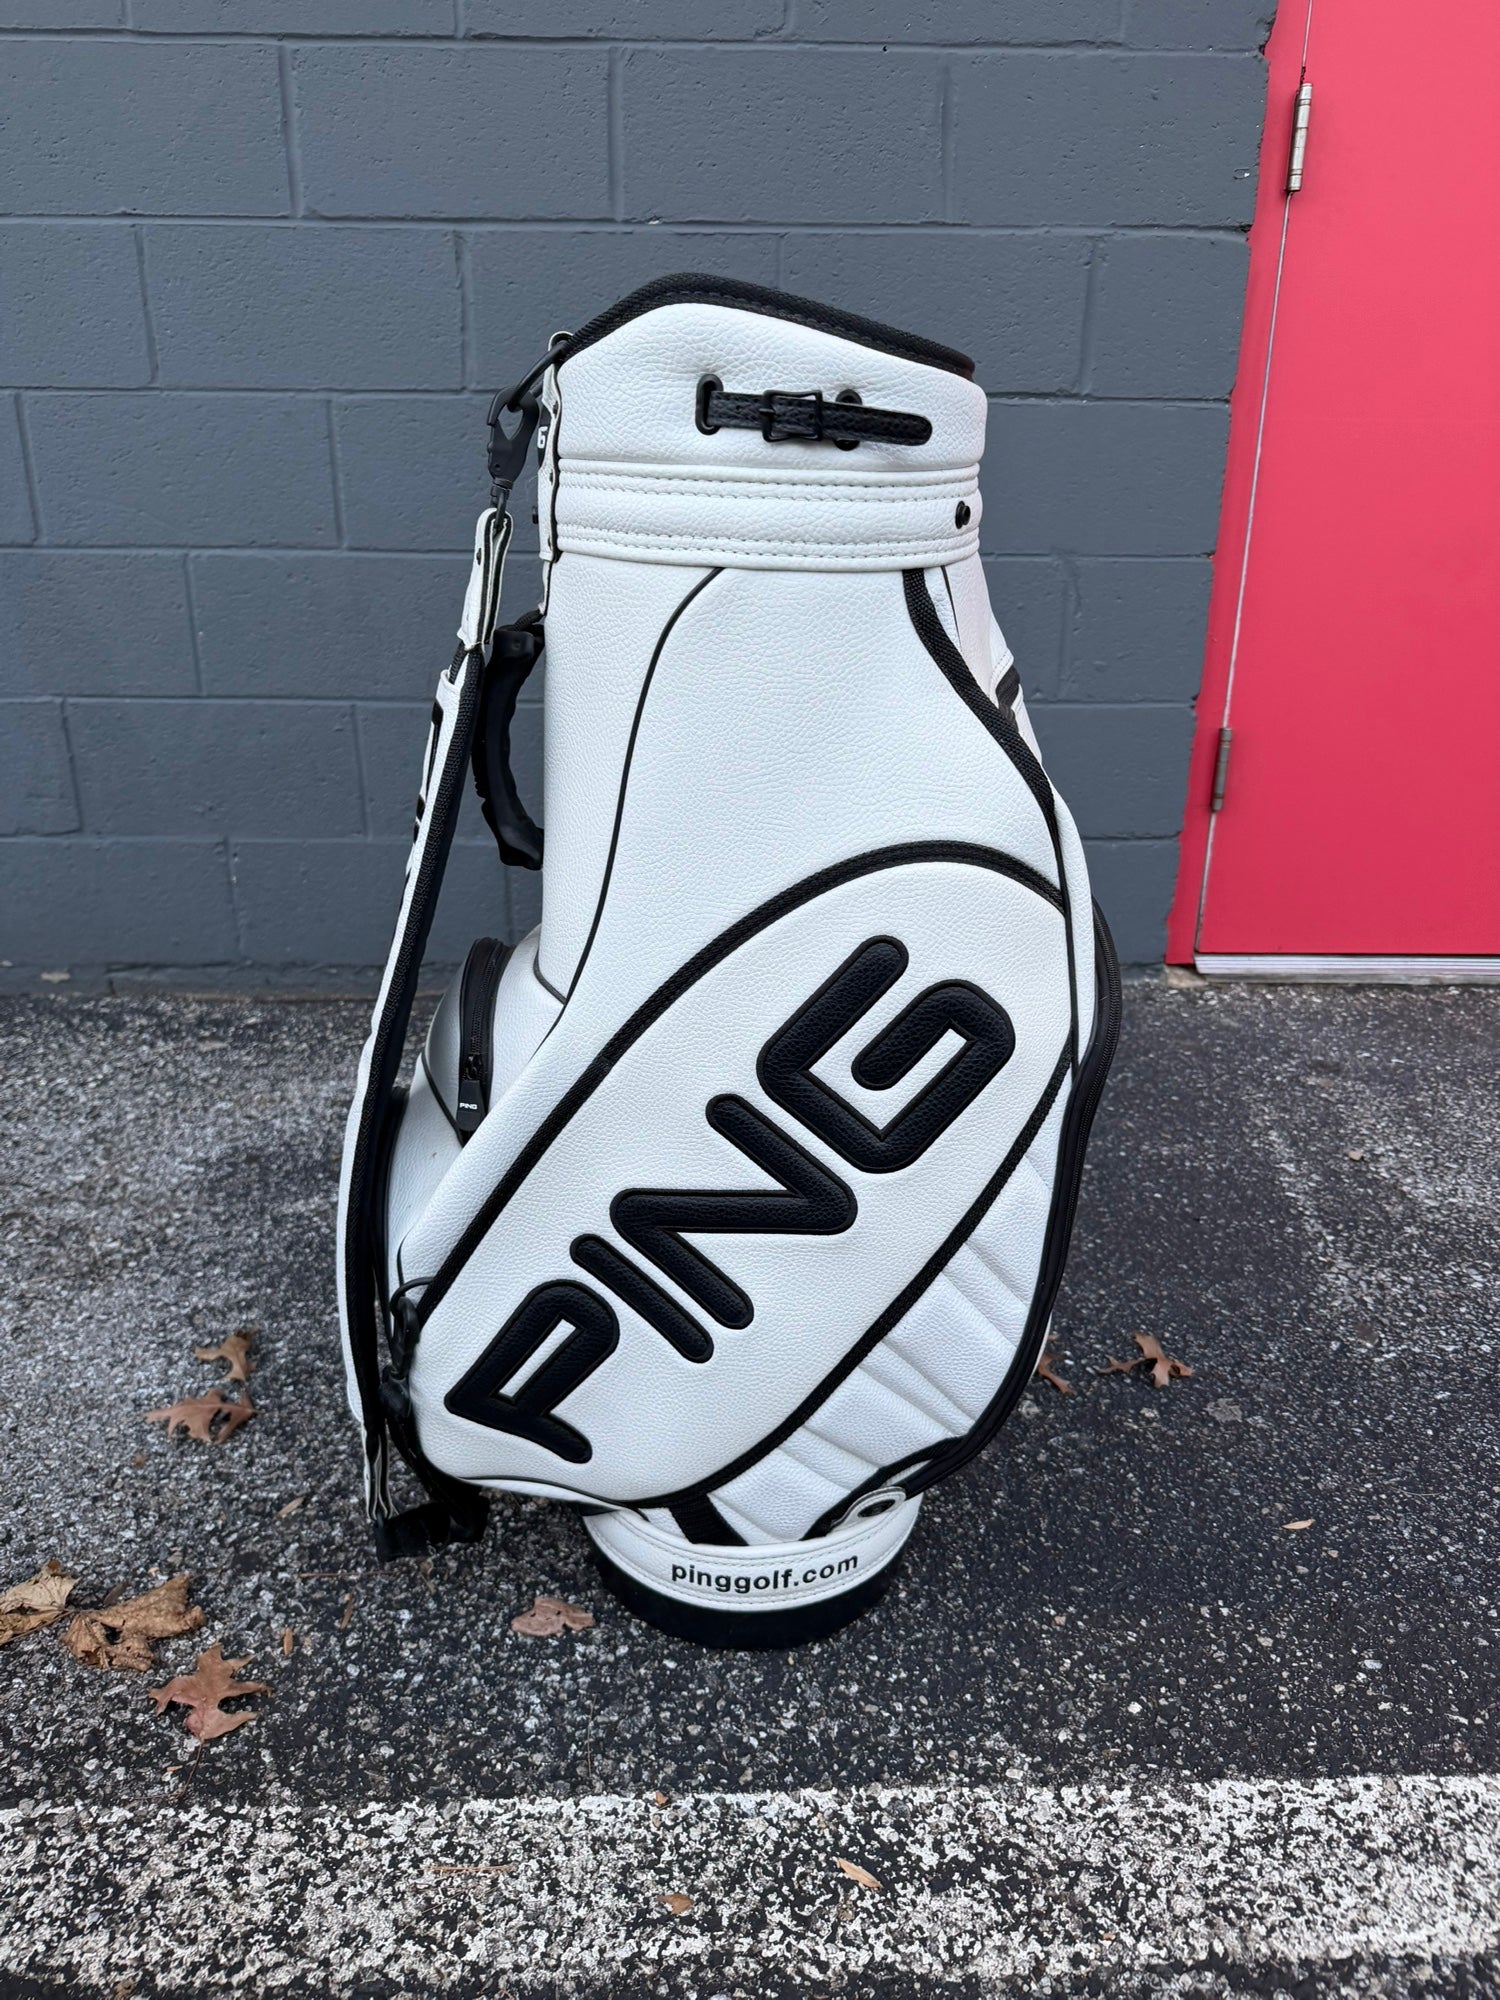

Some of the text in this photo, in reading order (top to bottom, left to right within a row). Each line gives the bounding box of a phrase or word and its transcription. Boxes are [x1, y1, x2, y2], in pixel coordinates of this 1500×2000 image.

[459, 1102, 478, 1110] PING
[443, 934, 1016, 1464] PING
[671, 1555, 858, 1594] pinggolf.com
